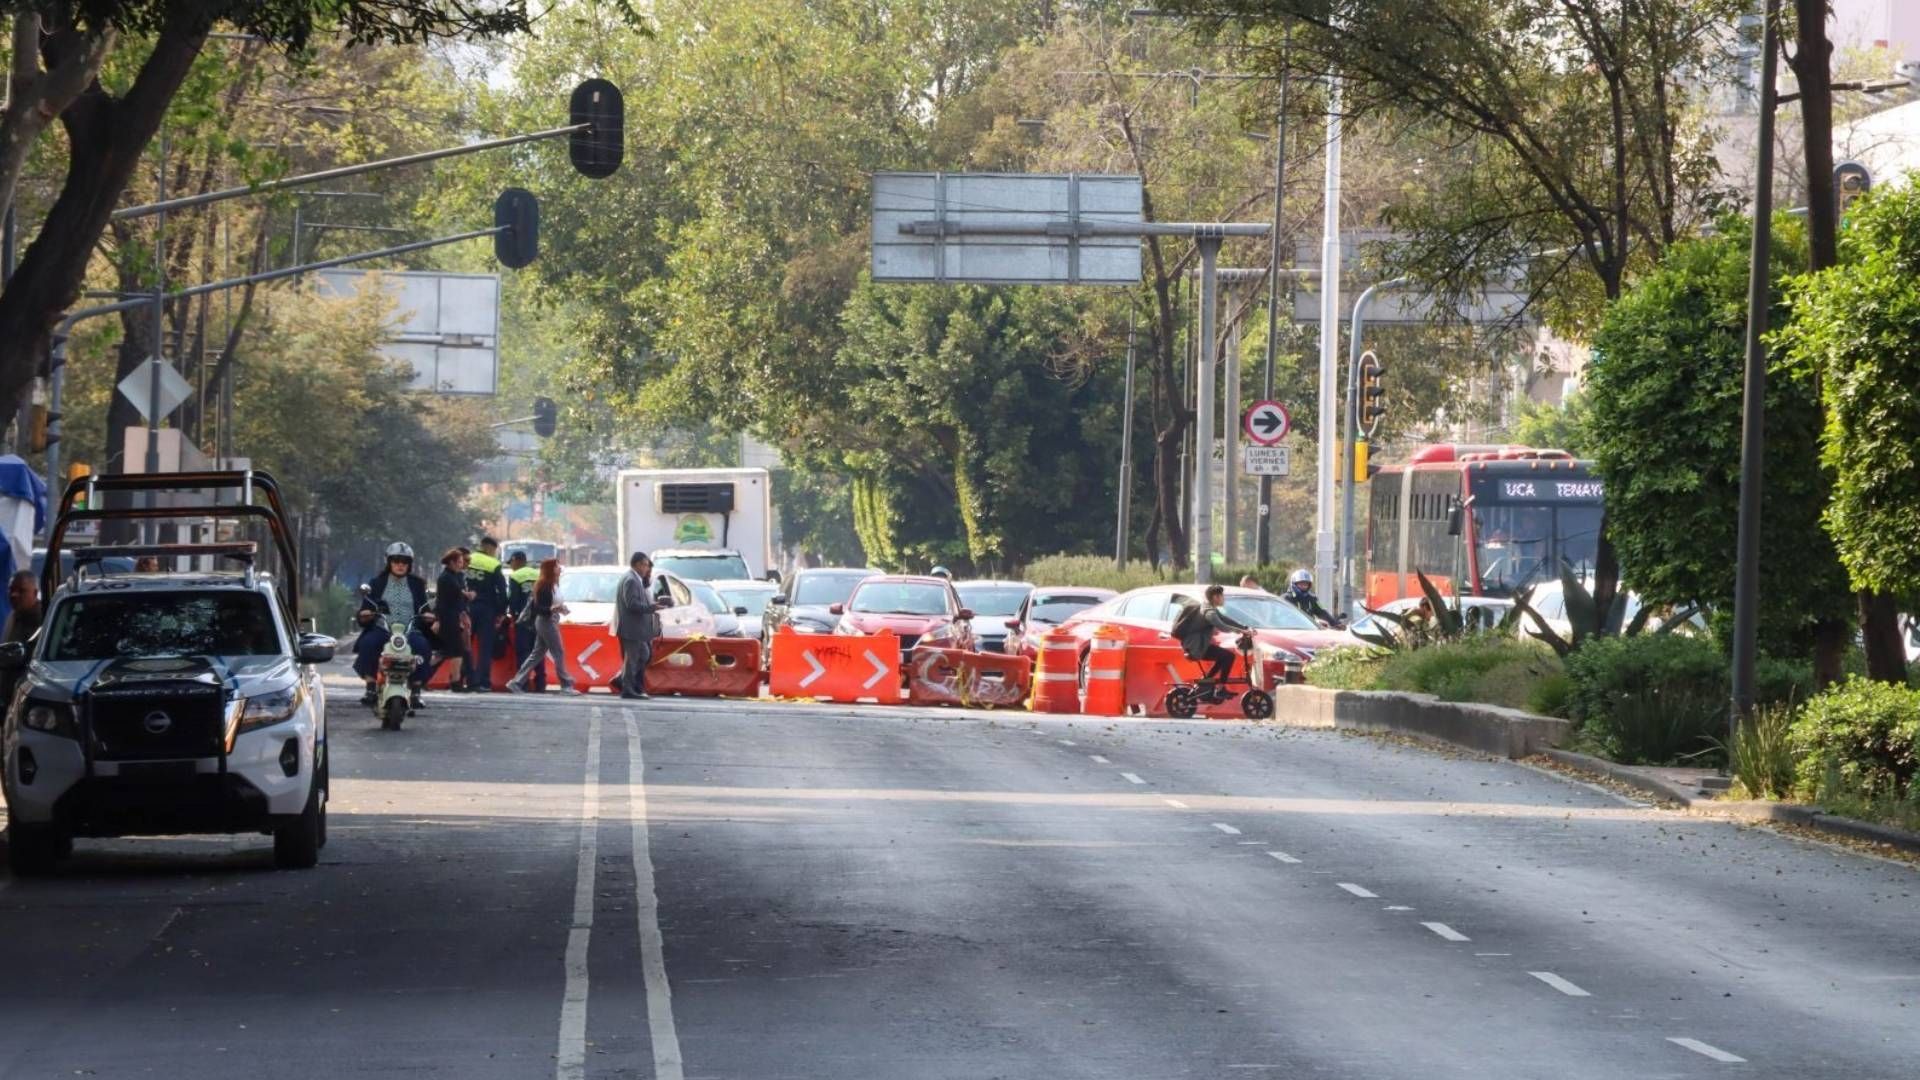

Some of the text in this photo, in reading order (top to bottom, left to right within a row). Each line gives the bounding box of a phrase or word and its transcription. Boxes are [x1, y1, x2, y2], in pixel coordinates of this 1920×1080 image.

[1249, 449, 1277, 457] LUNES
[1249, 457, 1286, 465] VIERNES
[1504, 482, 1603, 497] UCA TENAY
